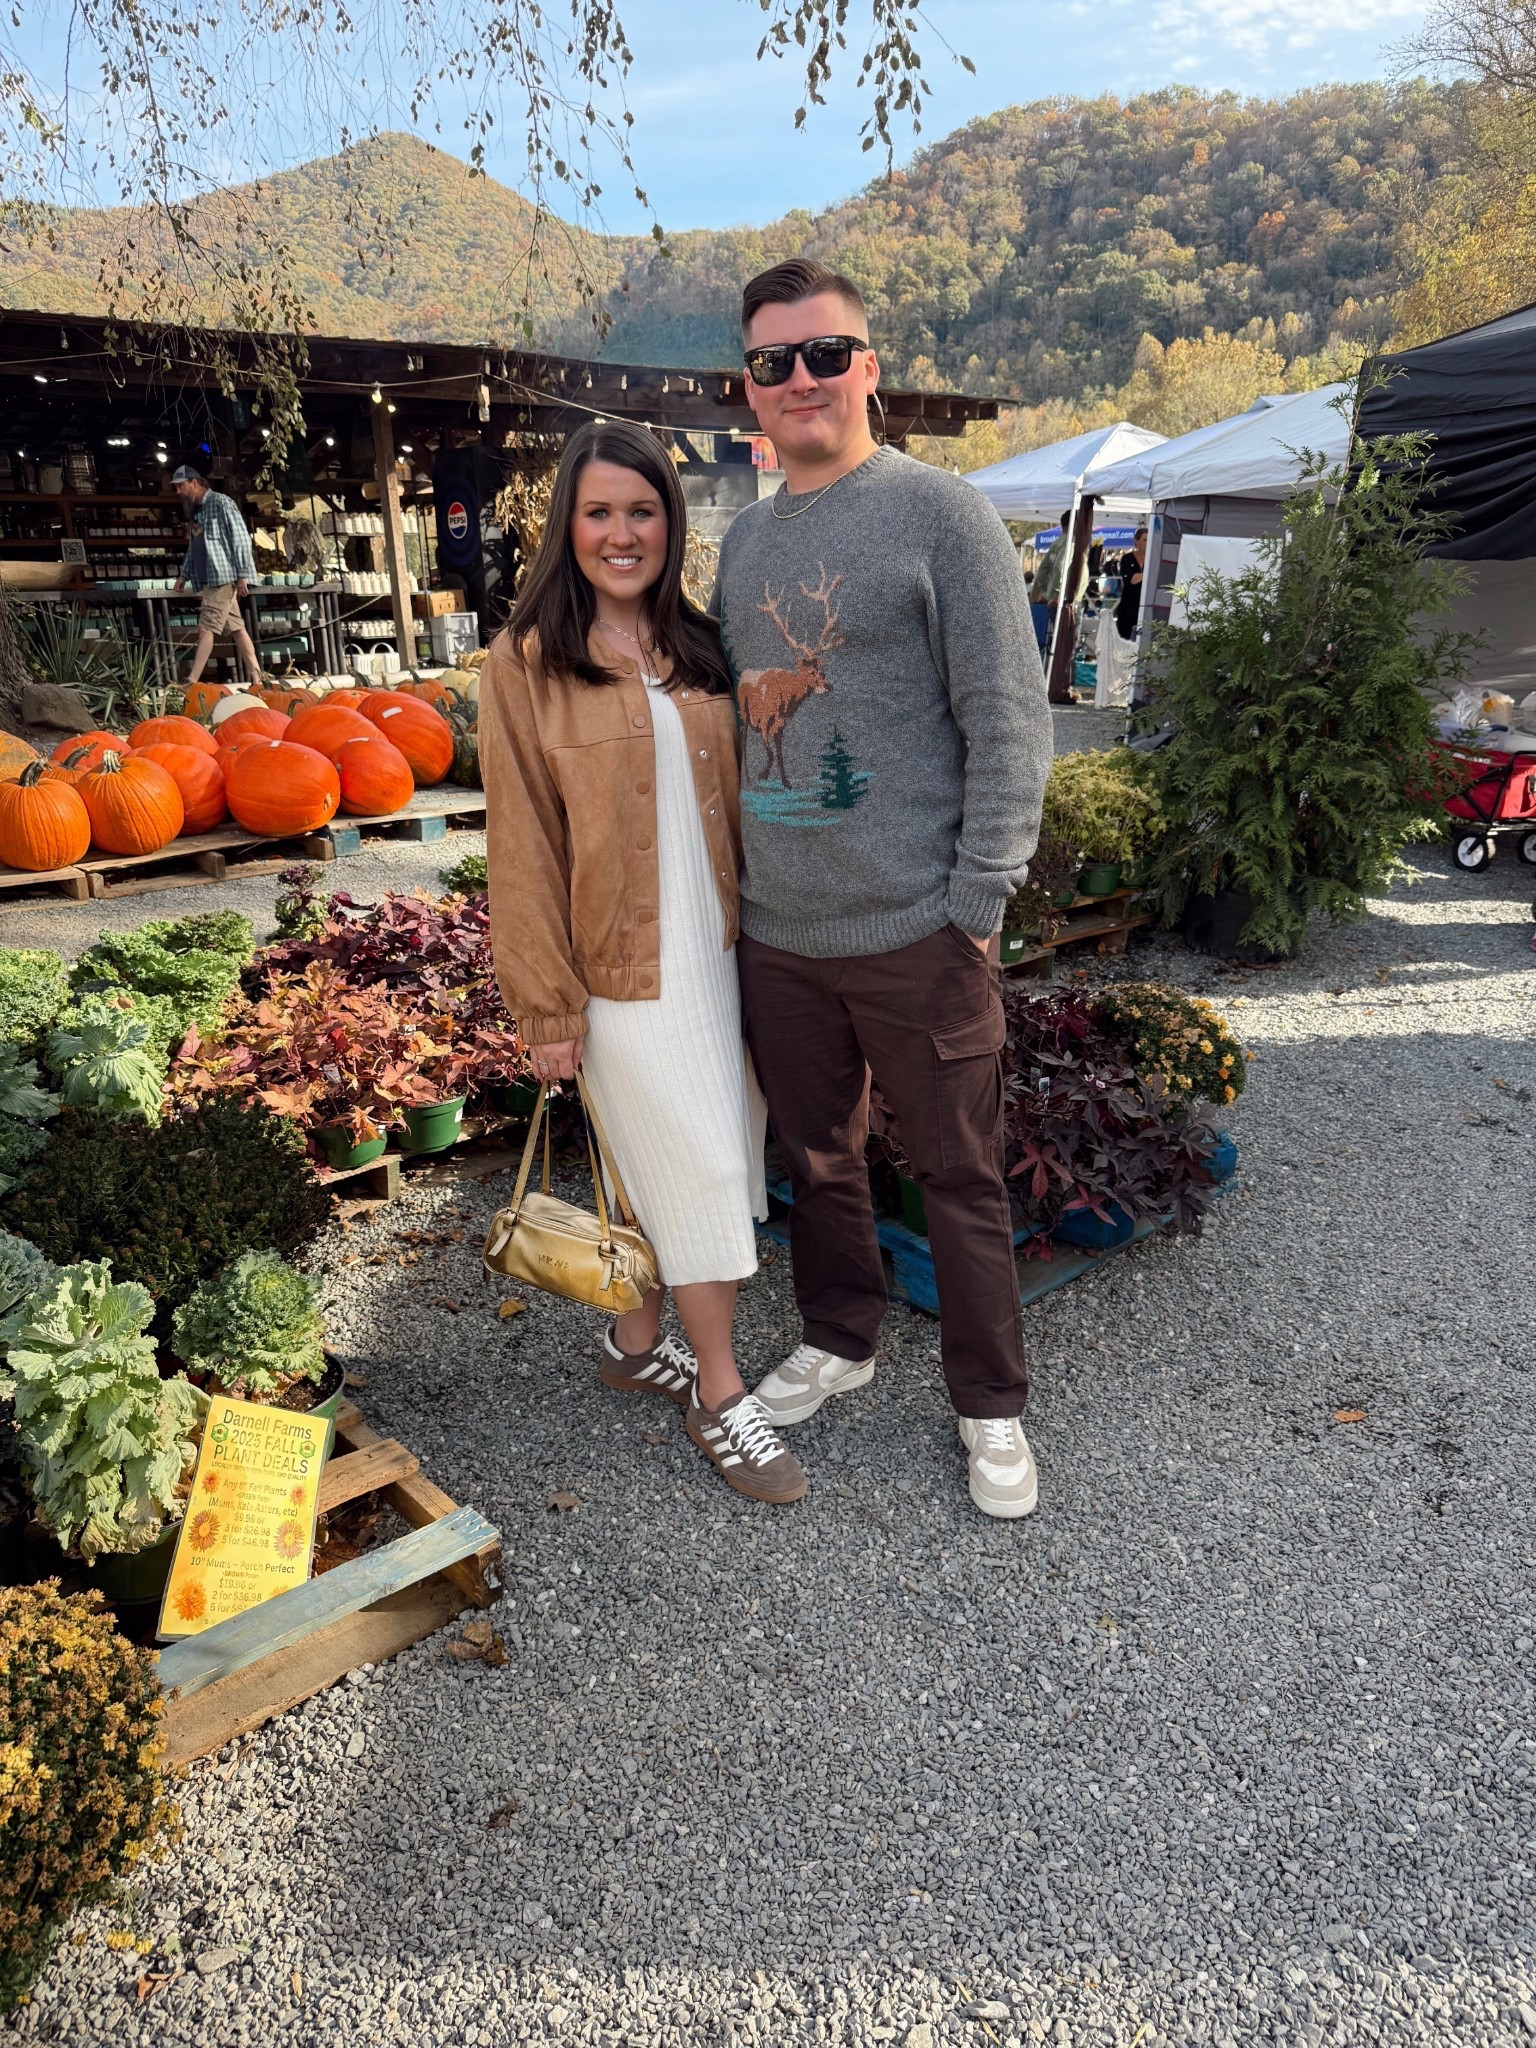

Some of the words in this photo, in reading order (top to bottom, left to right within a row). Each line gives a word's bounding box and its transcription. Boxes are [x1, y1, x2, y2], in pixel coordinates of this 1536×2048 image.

[450, 516, 466, 524] PEPSI
[223, 1409, 270, 1432] Darnell
[273, 1419, 312, 1440] Farms
[230, 1429, 262, 1448] 2025
[264, 1436, 298, 1455] FALL
[213, 1444, 260, 1466] PLANT
[263, 1452, 309, 1474] DEALS
[211, 1461, 232, 1469] LOCALLY
[287, 1472, 307, 1481] QUALITY
[222, 1479, 238, 1492] Any
[249, 1483, 262, 1493] Fall
[264, 1485, 287, 1496] Plants
[208, 1497, 235, 1511] (Mums,
[255, 1503, 281, 1516] Asters,
[282, 1507, 298, 1518] etc)
[225, 1523, 229, 1532] 3
[231, 1525, 243, 1533] for
[244, 1526, 271, 1536] $26.98
[222, 1535, 227, 1544] 5
[229, 1536, 240, 1545] for
[241, 1537, 270, 1548] $46.98
[190, 1556, 205, 1566] 10"
[206, 1558, 231, 1569] Mums
[240, 1560, 263, 1571] Porch
[265, 1563, 295, 1574] Perfect
[212, 1590, 217, 1600] 2
[219, 1591, 232, 1600] for
[233, 1591, 262, 1602] $36.98
[210, 1602, 215, 1611] 5
[217, 1603, 230, 1613] for
